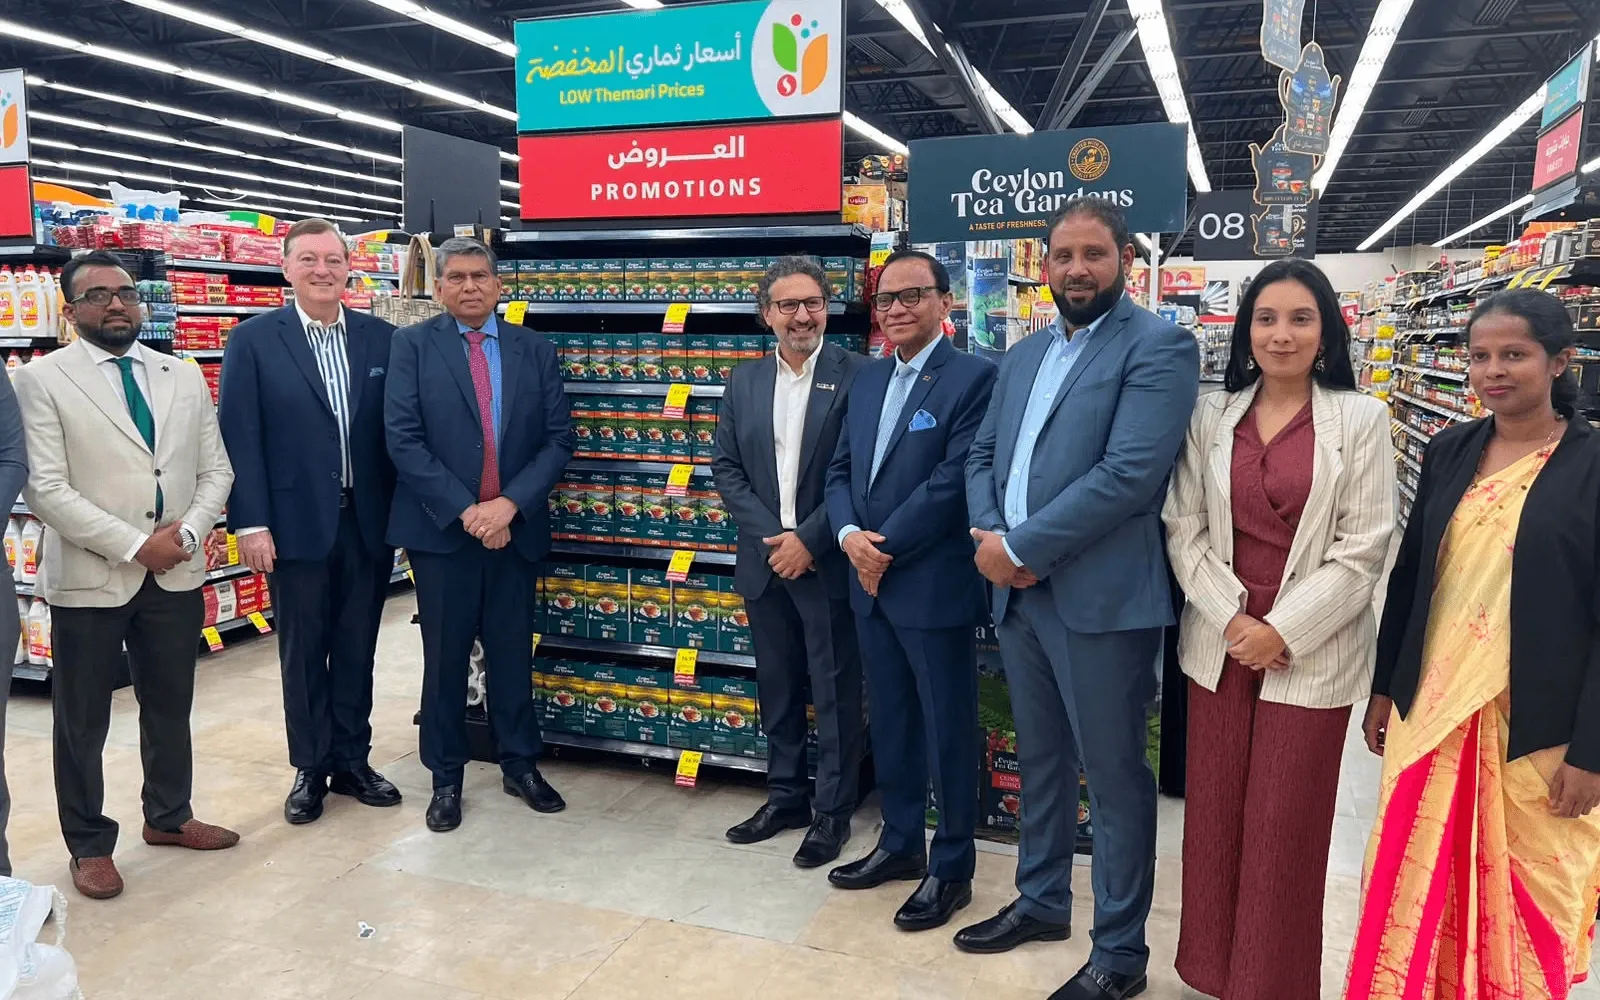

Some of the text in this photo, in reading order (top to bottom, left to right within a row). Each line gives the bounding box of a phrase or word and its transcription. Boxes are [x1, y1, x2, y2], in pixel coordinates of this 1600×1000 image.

[526, 31, 741, 83] أسعار ثماري المخفضة
[559, 82, 705, 105] LOW Themari Prices
[591, 177, 761, 201] PROMOTIONS
[971, 168, 1064, 197] Ceylon
[951, 192, 1004, 217] Tea
[969, 219, 1048, 231] A TASTE OF FRESHNESS,
[1198, 212, 1245, 240] 08
